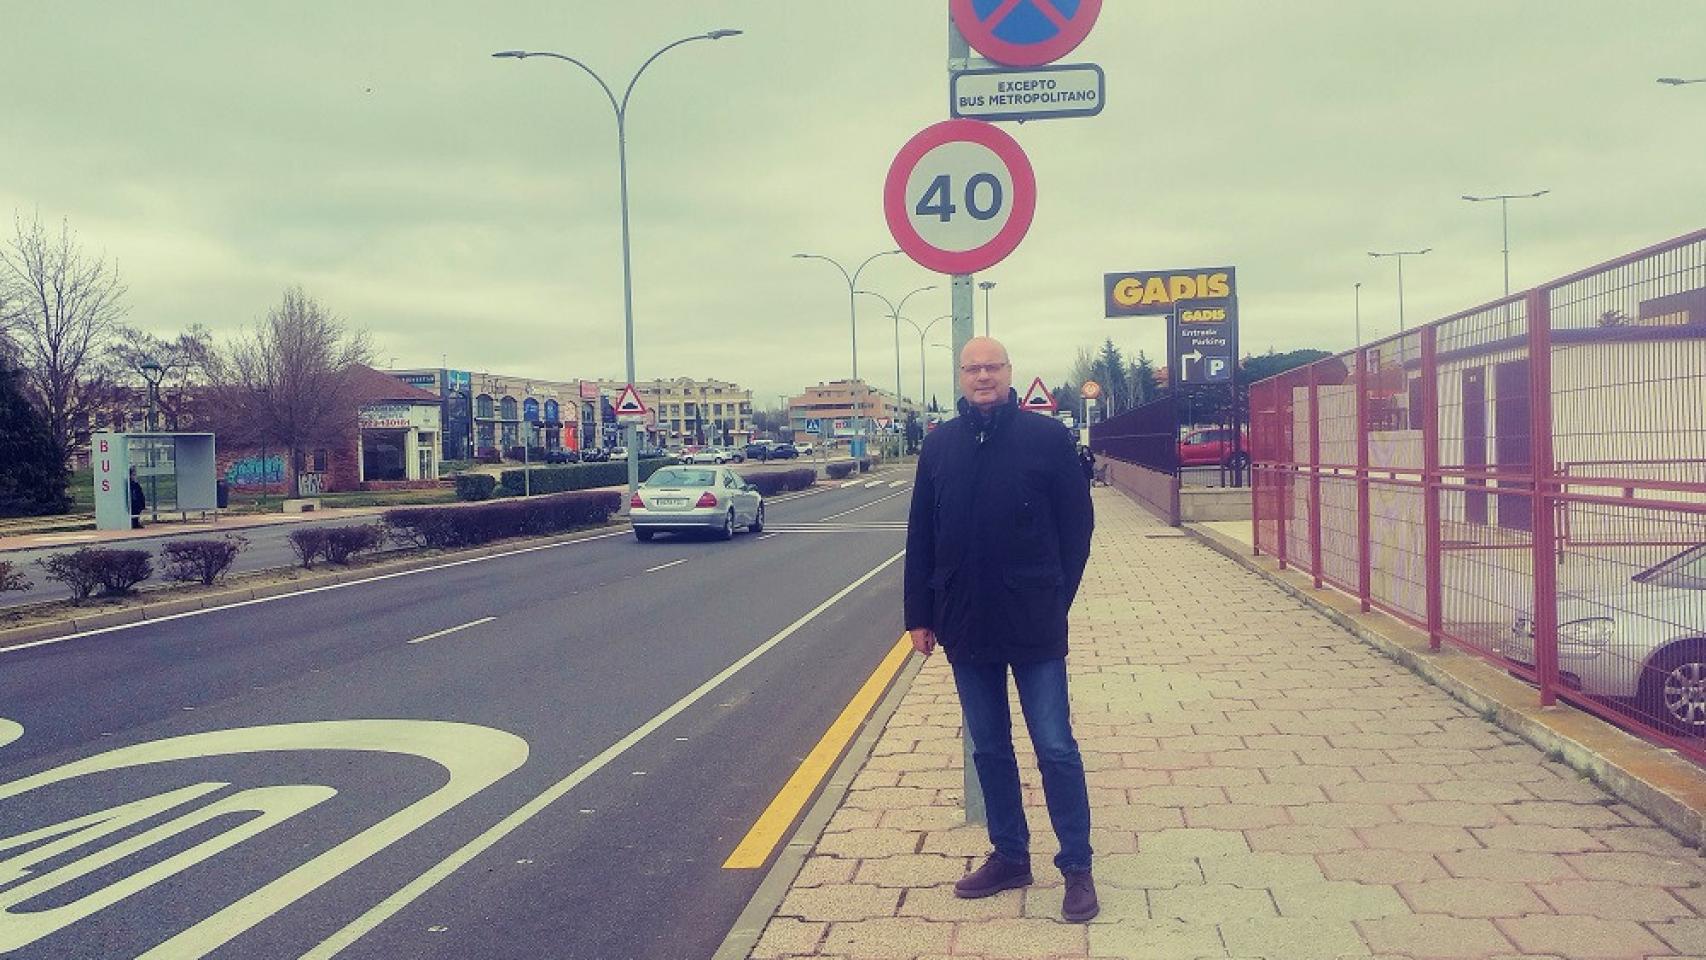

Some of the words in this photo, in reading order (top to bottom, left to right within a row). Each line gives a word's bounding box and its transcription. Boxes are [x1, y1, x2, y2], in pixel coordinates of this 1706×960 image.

[997, 80, 1057, 92] EXCEPTO
[959, 96, 985, 107] BUS
[989, 90, 1096, 106] METROPOLITANO
[915, 172, 1003, 222] 40
[1114, 274, 1230, 305] GADIS
[1182, 310, 1226, 322] GADIS
[1181, 328, 1217, 337] Entrada
[1192, 338, 1226, 346] Parking
[1210, 359, 1224, 376] P
[100, 440, 110, 491] BUS
